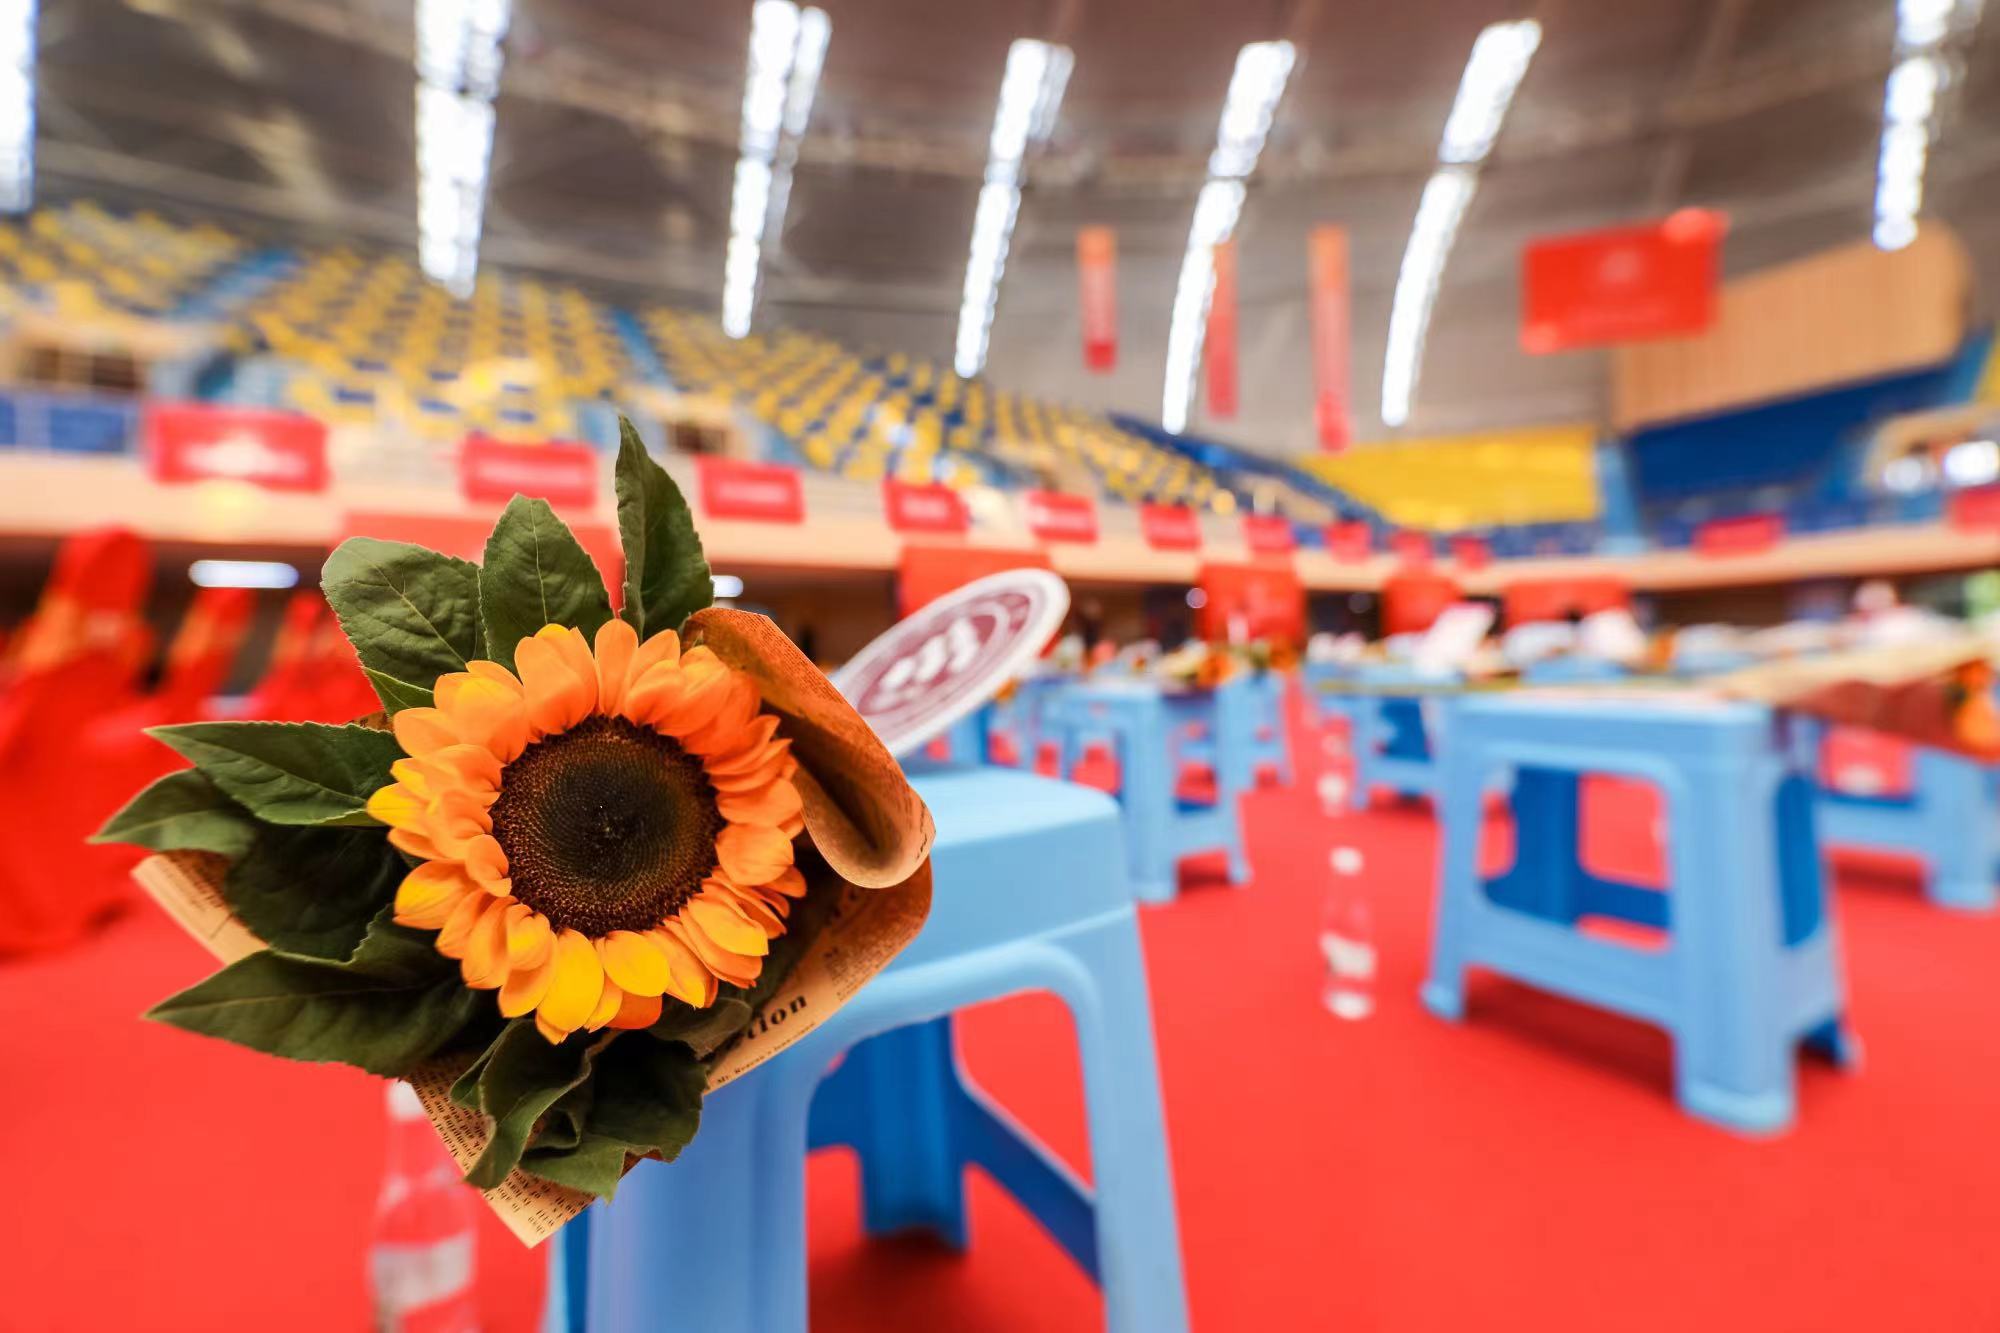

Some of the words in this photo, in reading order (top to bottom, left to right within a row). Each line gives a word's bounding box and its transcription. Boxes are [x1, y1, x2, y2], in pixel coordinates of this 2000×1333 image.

[434, 1101, 445, 1113] me
[443, 1097, 462, 1122] retun
[434, 1122, 459, 1157] Medical
[443, 1115, 476, 1157] prompting
[460, 1124, 474, 1139] and
